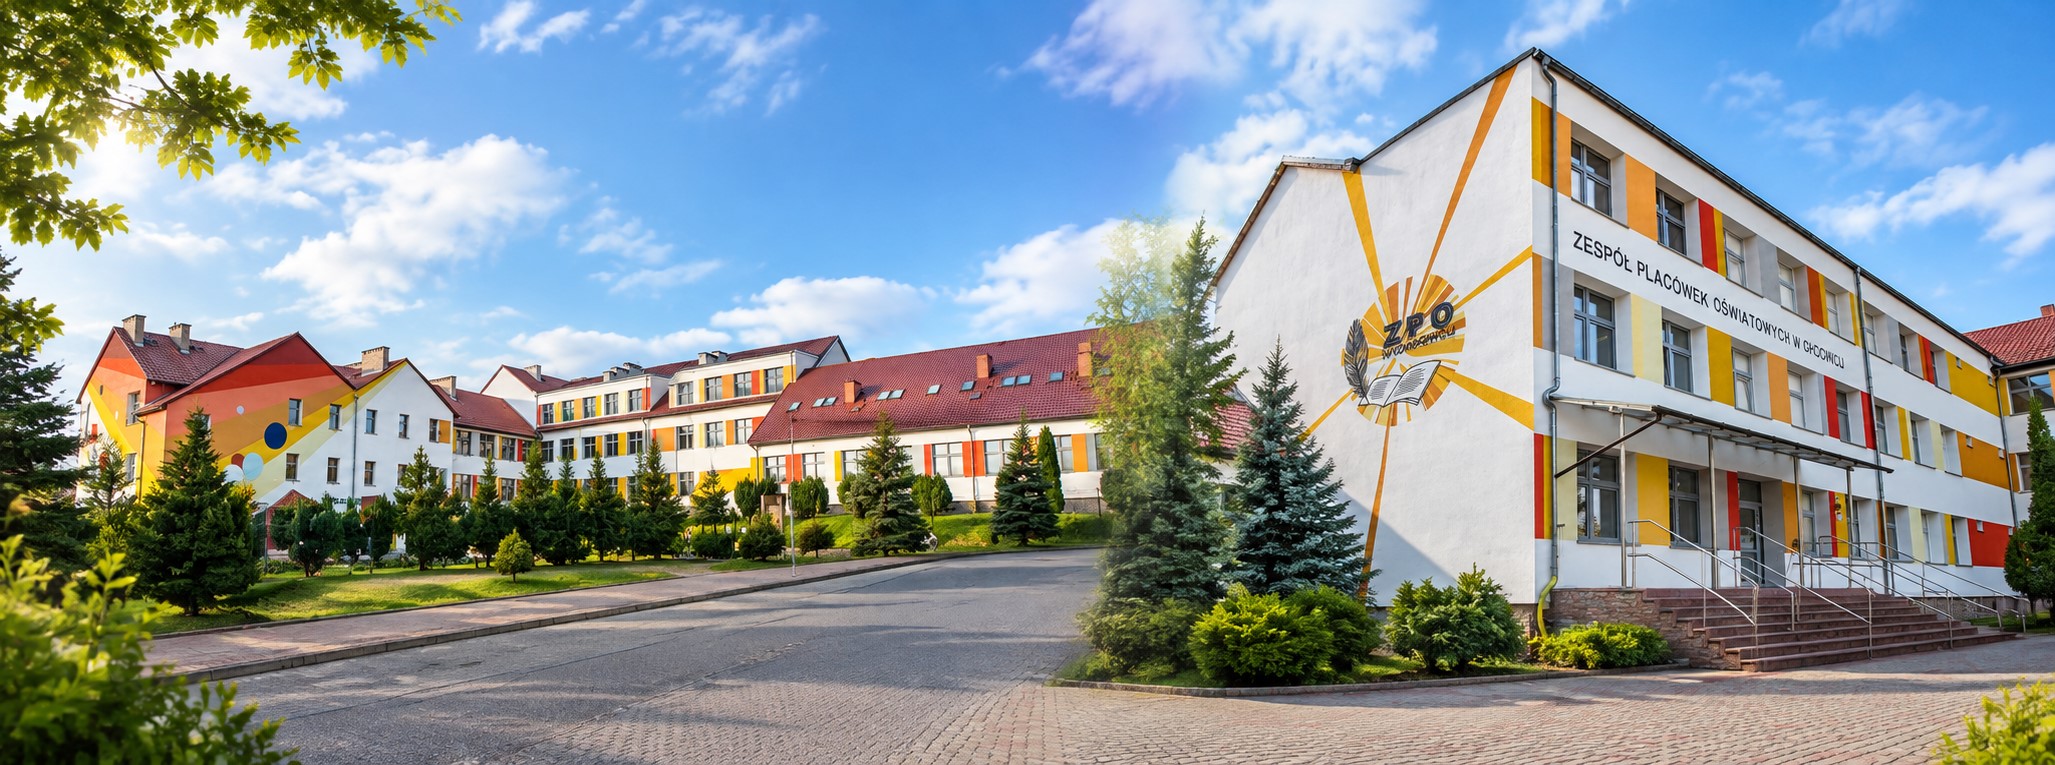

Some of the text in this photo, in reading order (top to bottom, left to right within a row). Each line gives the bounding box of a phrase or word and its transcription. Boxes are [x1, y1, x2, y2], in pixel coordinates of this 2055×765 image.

[1573, 230, 1633, 273] ZESPÓŁ
[1637, 260, 1709, 308] PLACÓWEK
[1713, 297, 1791, 345] OŚWIATOWYCH
[1792, 334, 1801, 350] W
